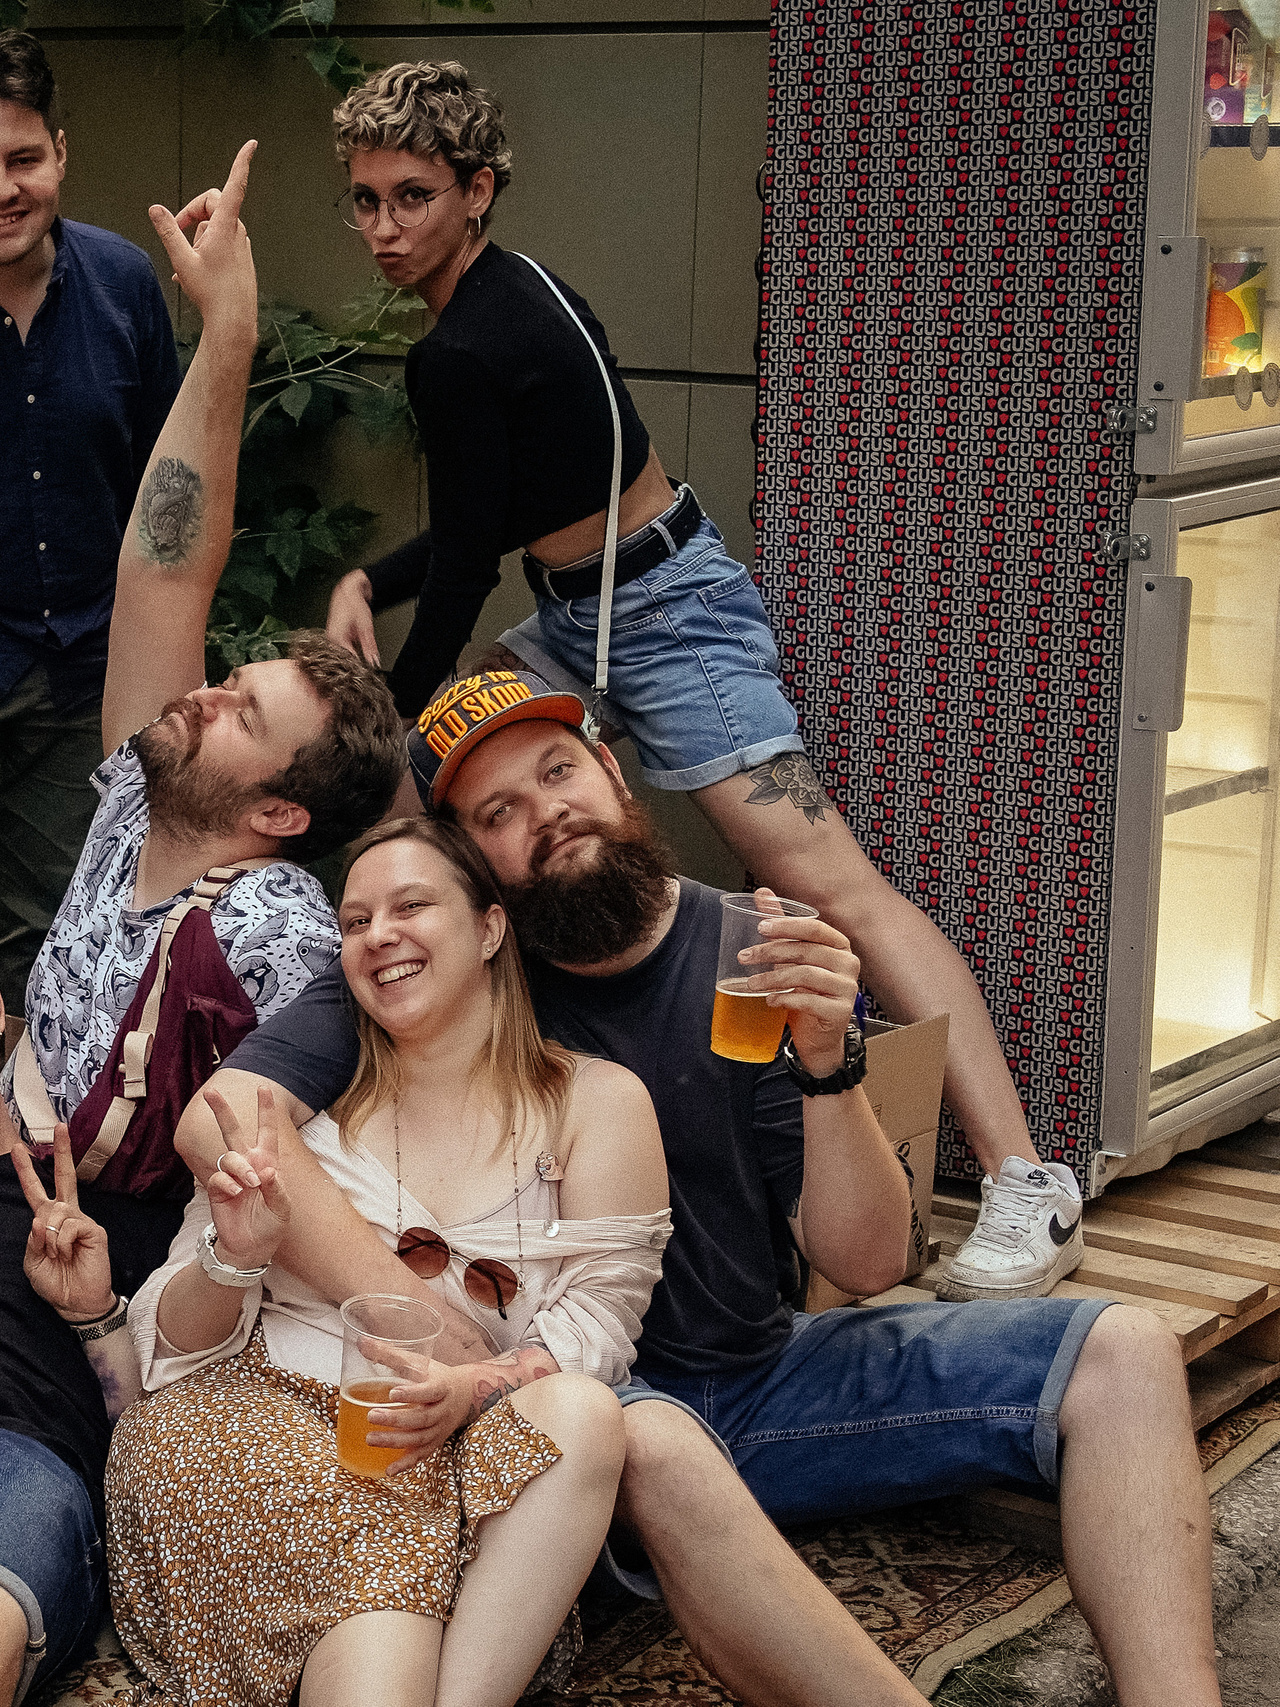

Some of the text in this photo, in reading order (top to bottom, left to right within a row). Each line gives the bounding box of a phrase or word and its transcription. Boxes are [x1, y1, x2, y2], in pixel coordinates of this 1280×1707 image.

[815, 0, 1113, 24] GUSI GUSI GUSI GUSI GUSI GUSI
[778, 42, 1121, 70] GUSI GUSI GUSI GUSI GUSI GUSI GUSI
[812, 90, 1105, 114] GUSI GUSI GUSI GUSI GUSI GUSI
[775, 137, 1116, 161] GUSI GUSI GUSI GUSI GUSI GUSI GUSI
[809, 184, 1100, 203] GUSI GUSI GUSI GUSI GUSI GUSI
[772, 231, 1111, 248] GUSI GUSI GUSI GUSI GUSI GUSI GUSI
[806, 275, 1095, 292] GUSI GUSI GUSI GUSI GUSI GUSI
[770, 318, 1106, 339] GUSI GUSI GUSI GUSI GUSI GUSI GUSI
[804, 362, 1091, 383] GUSI GUSI GUSI GUSI GUSI GUSI
[768, 403, 1049, 428] GUSI GUSI GUSI GUSI GUSI GUSI
[801, 448, 1086, 474] GUSI GUSI GUSI GUSI GUSI GUSI
[765, 488, 1097, 520] GUSI GUSI GUSI GUSI GUSI GUSI GUSI
[798, 532, 1082, 564] GUSI GUSI GUSI GUSI GUSI GUSI
[763, 572, 1093, 609] GUSI GUSI GUSI GUSI GUSI GUSI GUSI
[796, 617, 1079, 652] GUSI GUSI GUSI GUSI GUSI GUSI
[806, 658, 1088, 696] GUSI GUSI GUSI GUSI GUSI GUSI
[418, 671, 518, 733] Sorry I'm
[426, 710, 469, 759] OLD
[839, 704, 1073, 740] GUSI GUSI GUSI GUSI GUSI
[850, 746, 1084, 783] GUSI GUSI GUSI GUSI GUSI
[836, 785, 1070, 827] GUSI GUSI GUSI GUSI GUSI
[894, 834, 1079, 869] GUSI GUSI GUSI GUSI
[928, 881, 1066, 912] GUSI GUSI GUSI
[987, 928, 1075, 954] GUSI GUSI
[1022, 977, 1062, 997] GUSI
[1033, 1018, 1071, 1038] GUSI
[1018, 1057, 1058, 1079] GUSI
